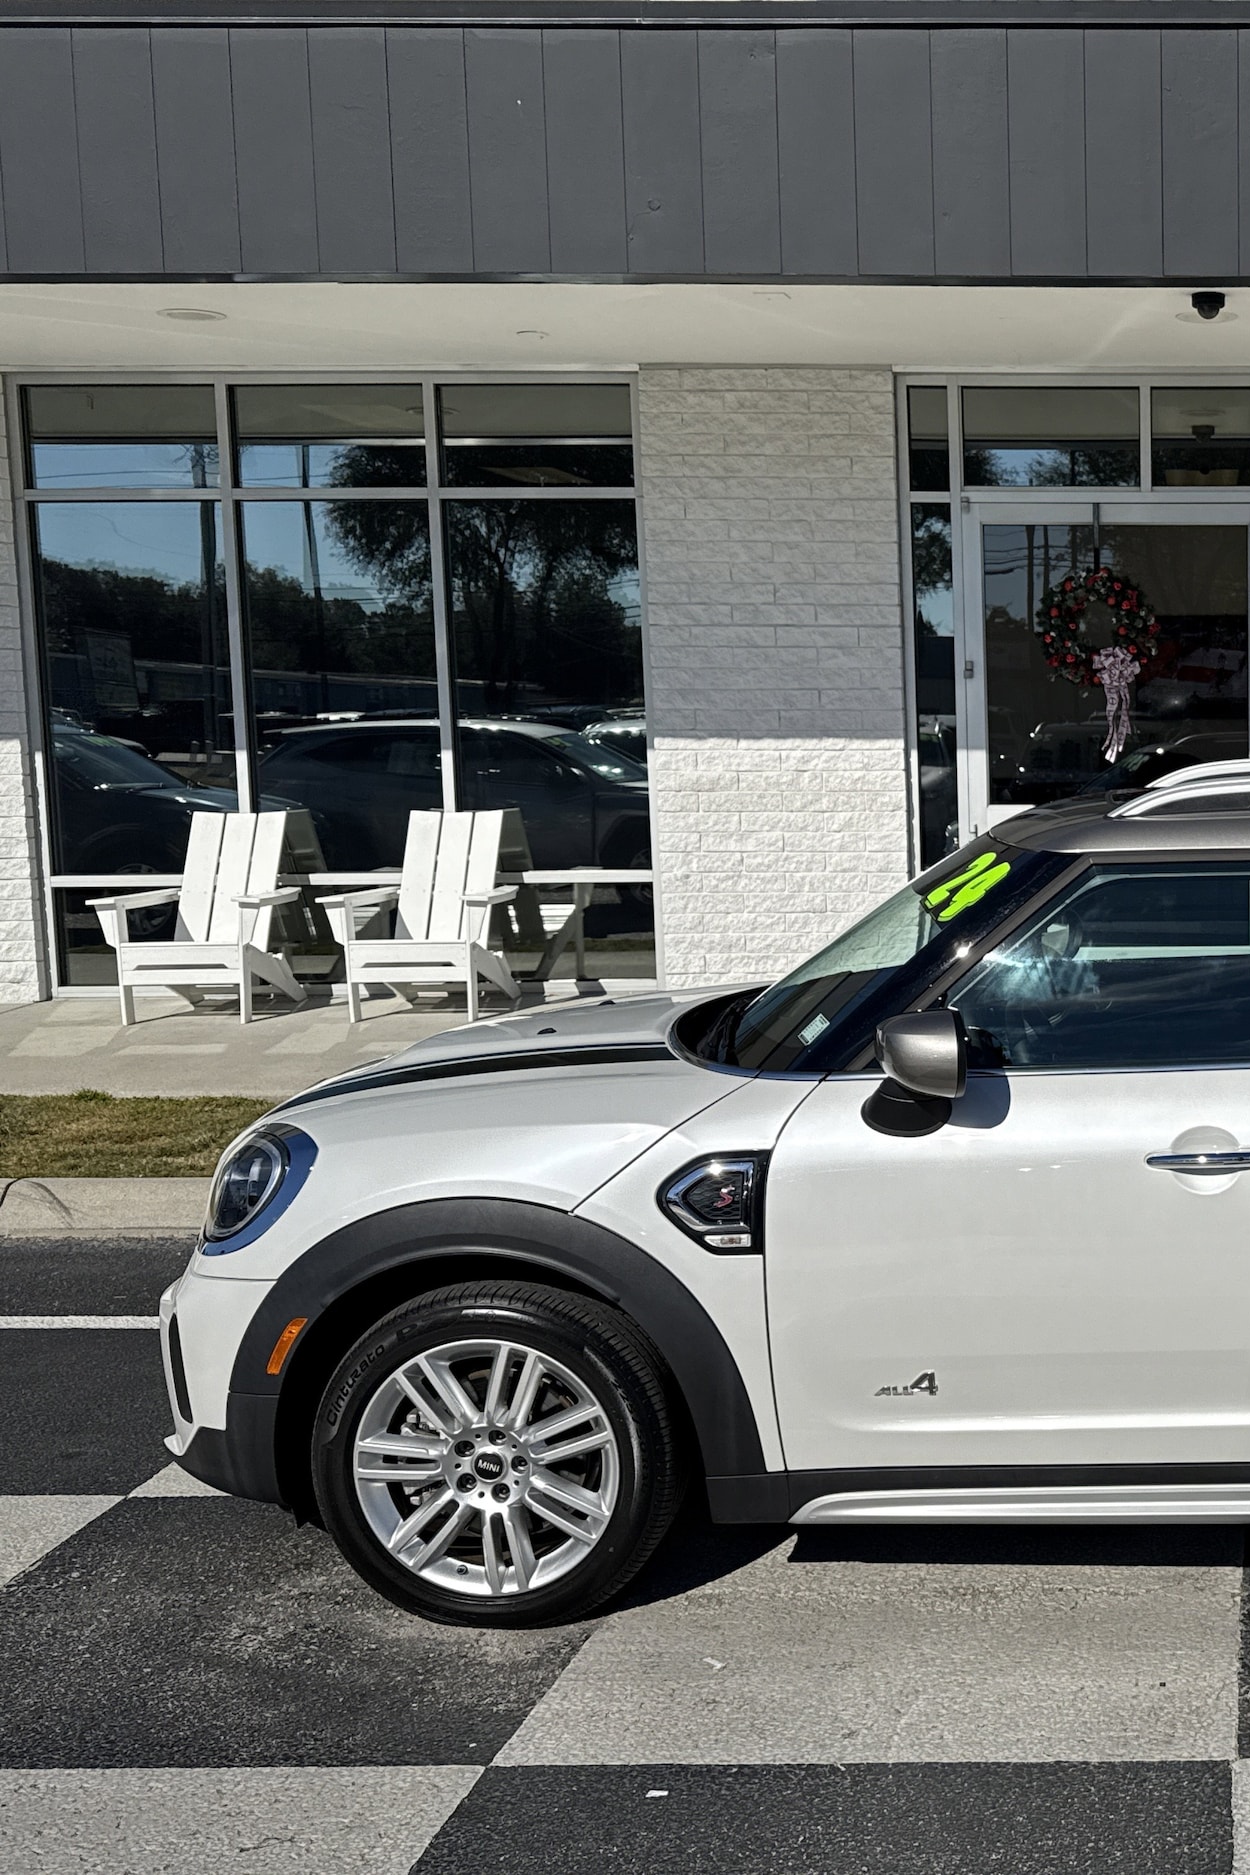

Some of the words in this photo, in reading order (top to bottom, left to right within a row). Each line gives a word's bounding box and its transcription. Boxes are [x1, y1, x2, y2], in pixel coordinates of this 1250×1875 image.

[925, 851, 1011, 922] 24
[713, 1184, 735, 1208] S
[478, 1459, 500, 1473] MINI
